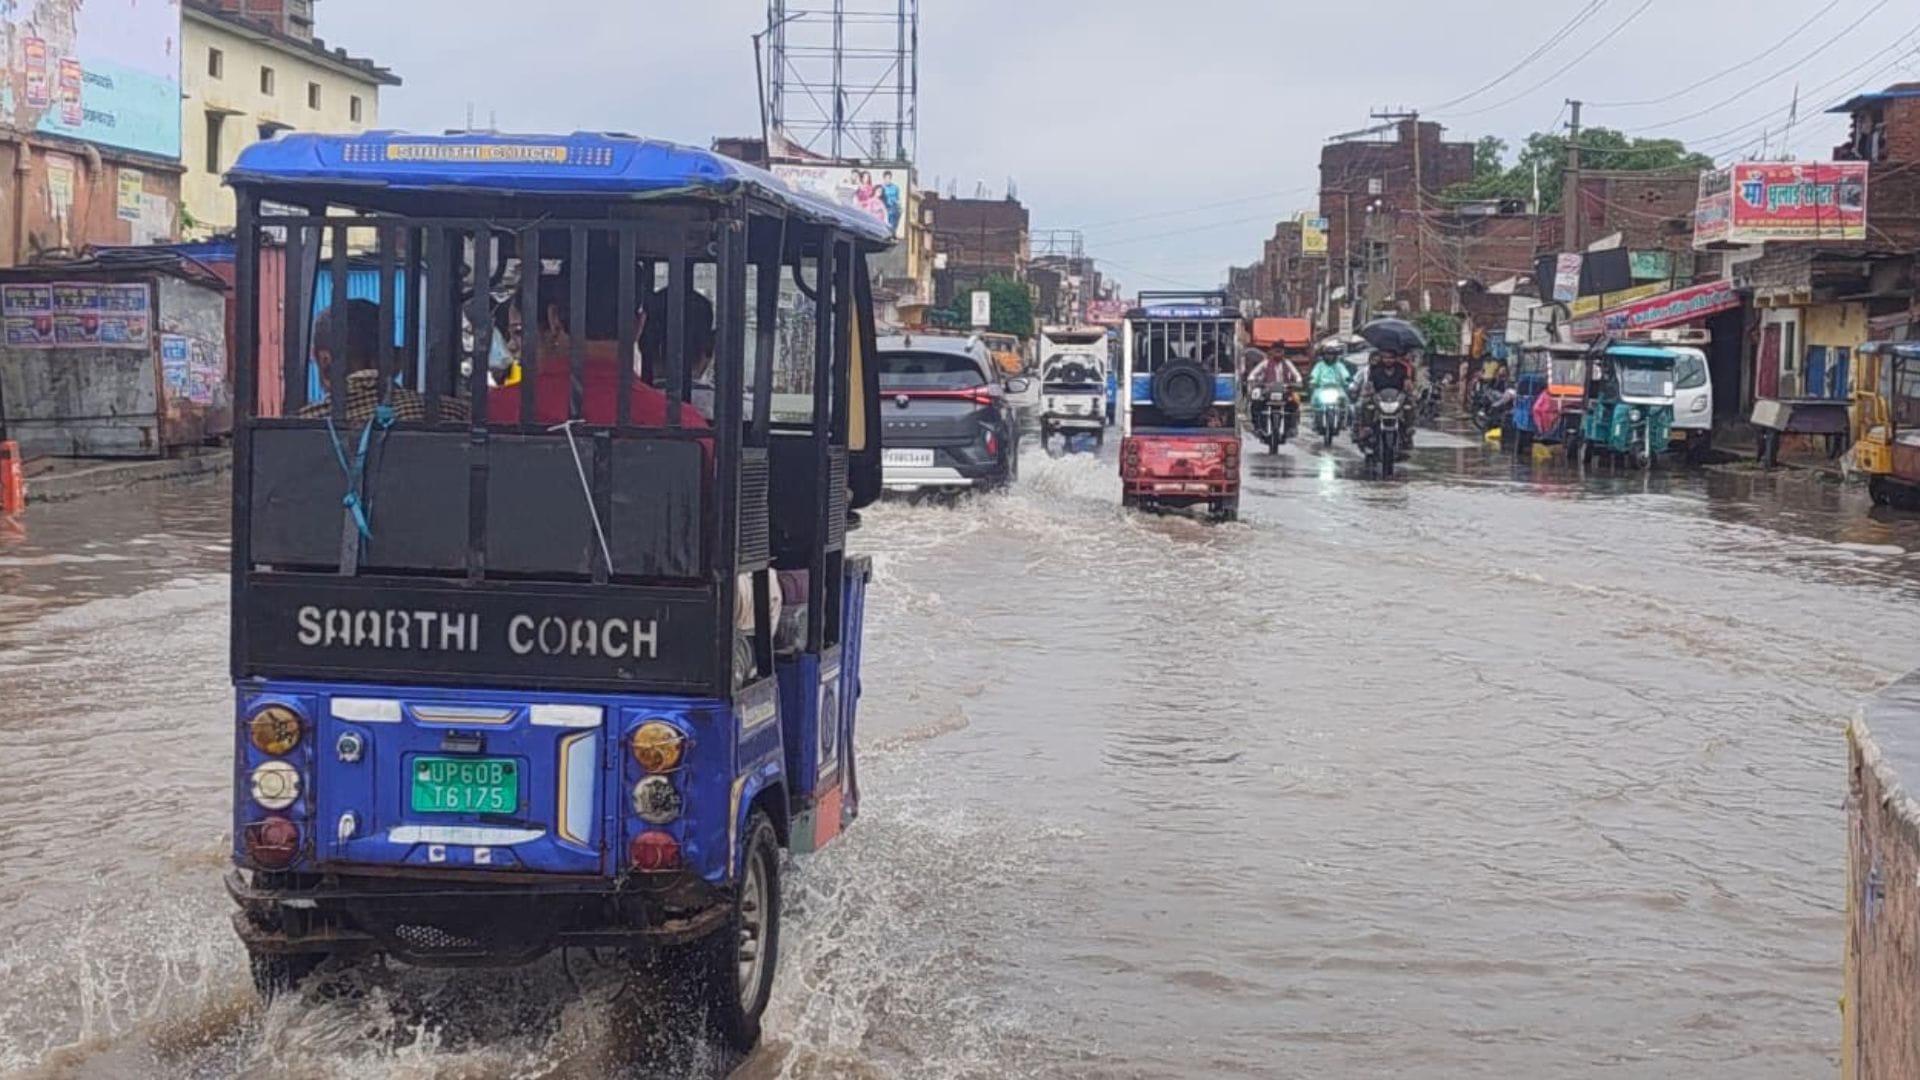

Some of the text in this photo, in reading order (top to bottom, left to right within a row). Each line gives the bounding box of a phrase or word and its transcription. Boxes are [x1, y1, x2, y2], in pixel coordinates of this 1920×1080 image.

[297, 606, 660, 658] SAARTHI COACH
[432, 763, 503, 785] UP60B
[434, 787, 503, 808] T6175
